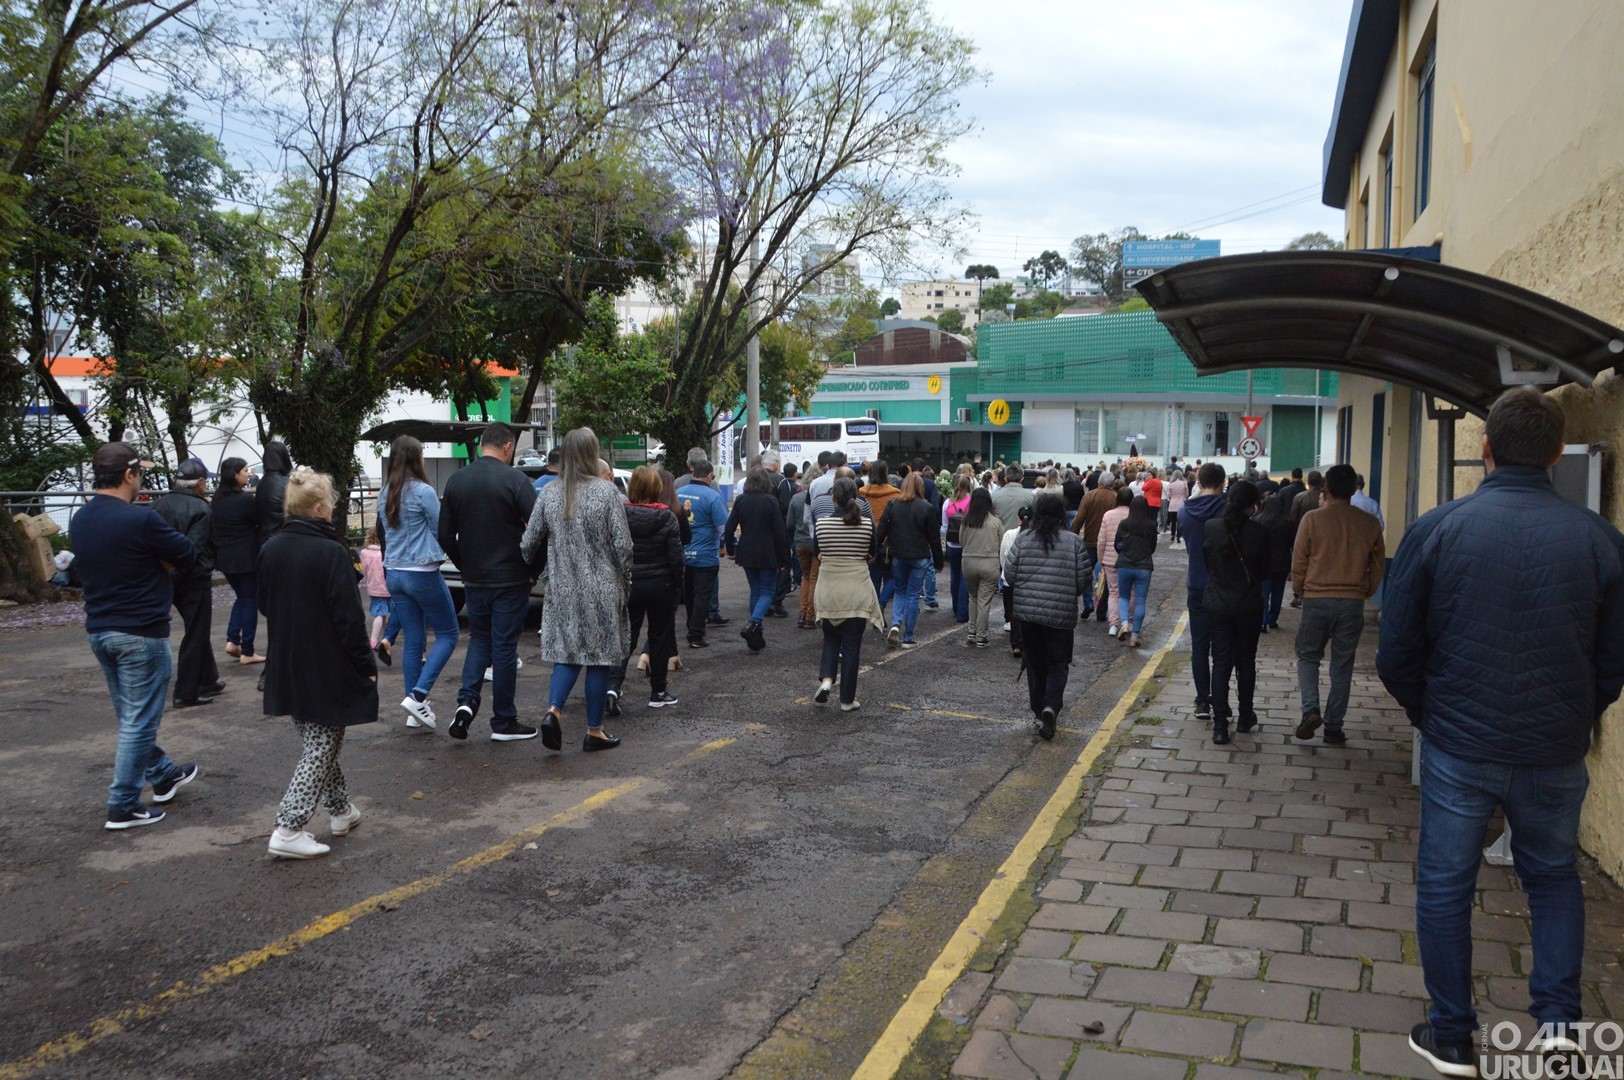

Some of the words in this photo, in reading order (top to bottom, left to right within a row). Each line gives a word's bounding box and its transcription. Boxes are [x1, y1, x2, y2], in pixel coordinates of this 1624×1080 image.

[1136, 268, 1154, 276] CTG
[868, 380, 910, 391] COTRIFRED
[779, 443, 801, 453] ZZONETTO
